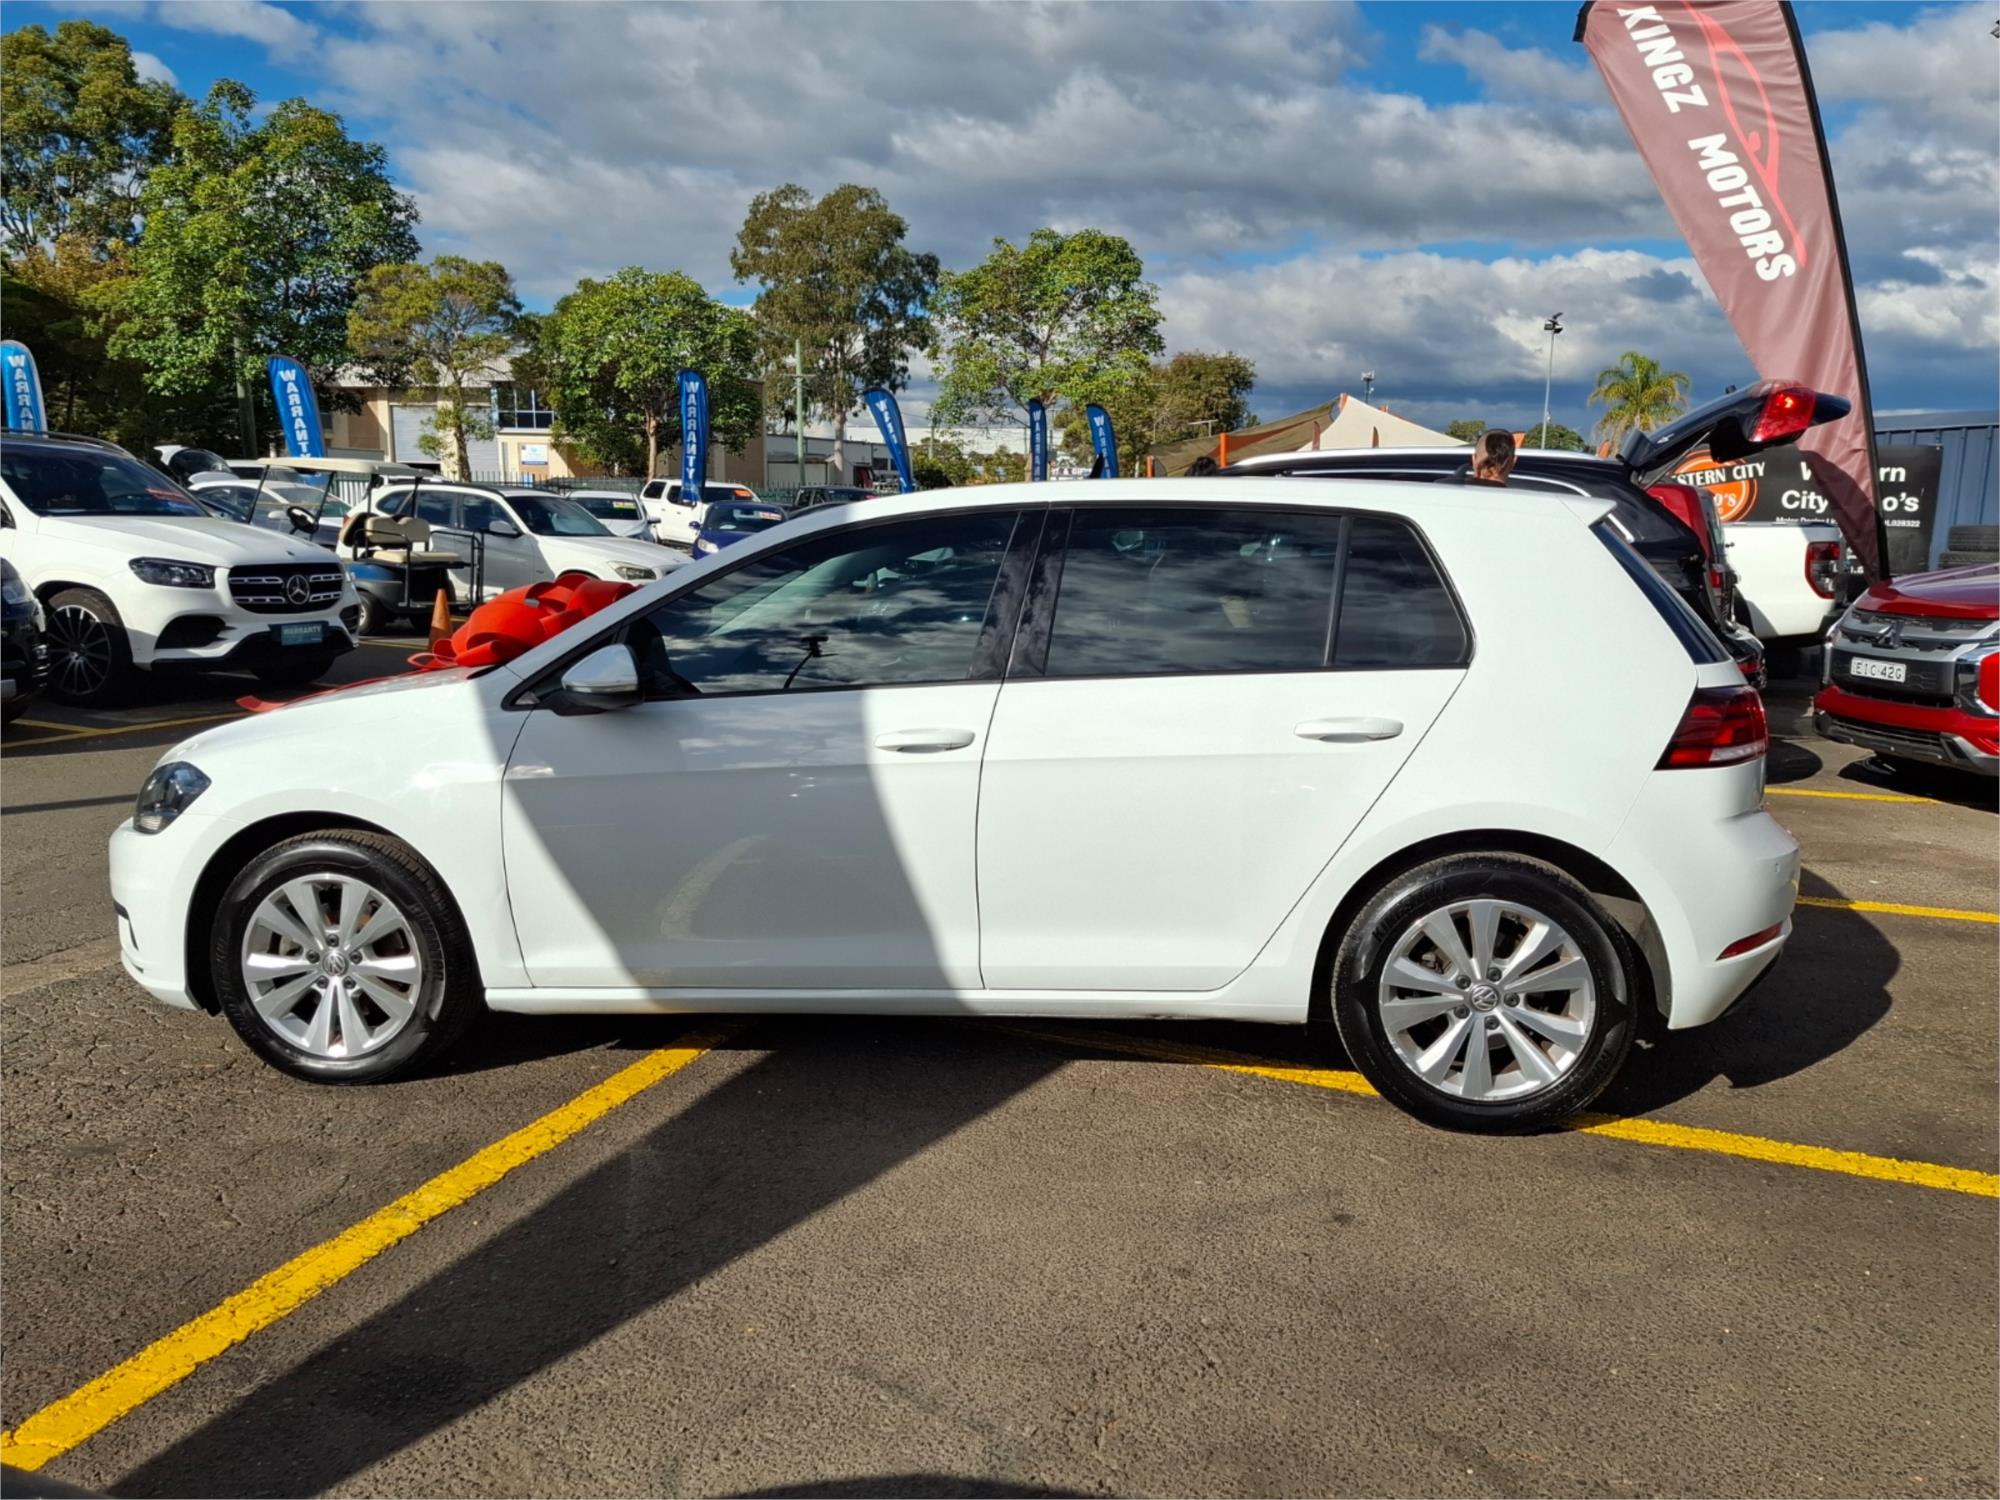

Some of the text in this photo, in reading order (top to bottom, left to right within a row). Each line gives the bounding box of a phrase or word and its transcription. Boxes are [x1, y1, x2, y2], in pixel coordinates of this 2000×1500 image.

[1616, 4, 1796, 282] KINGZ MOTORS
[1671, 461, 1766, 487] STERN CITY
[1781, 489, 1920, 514] City o's
